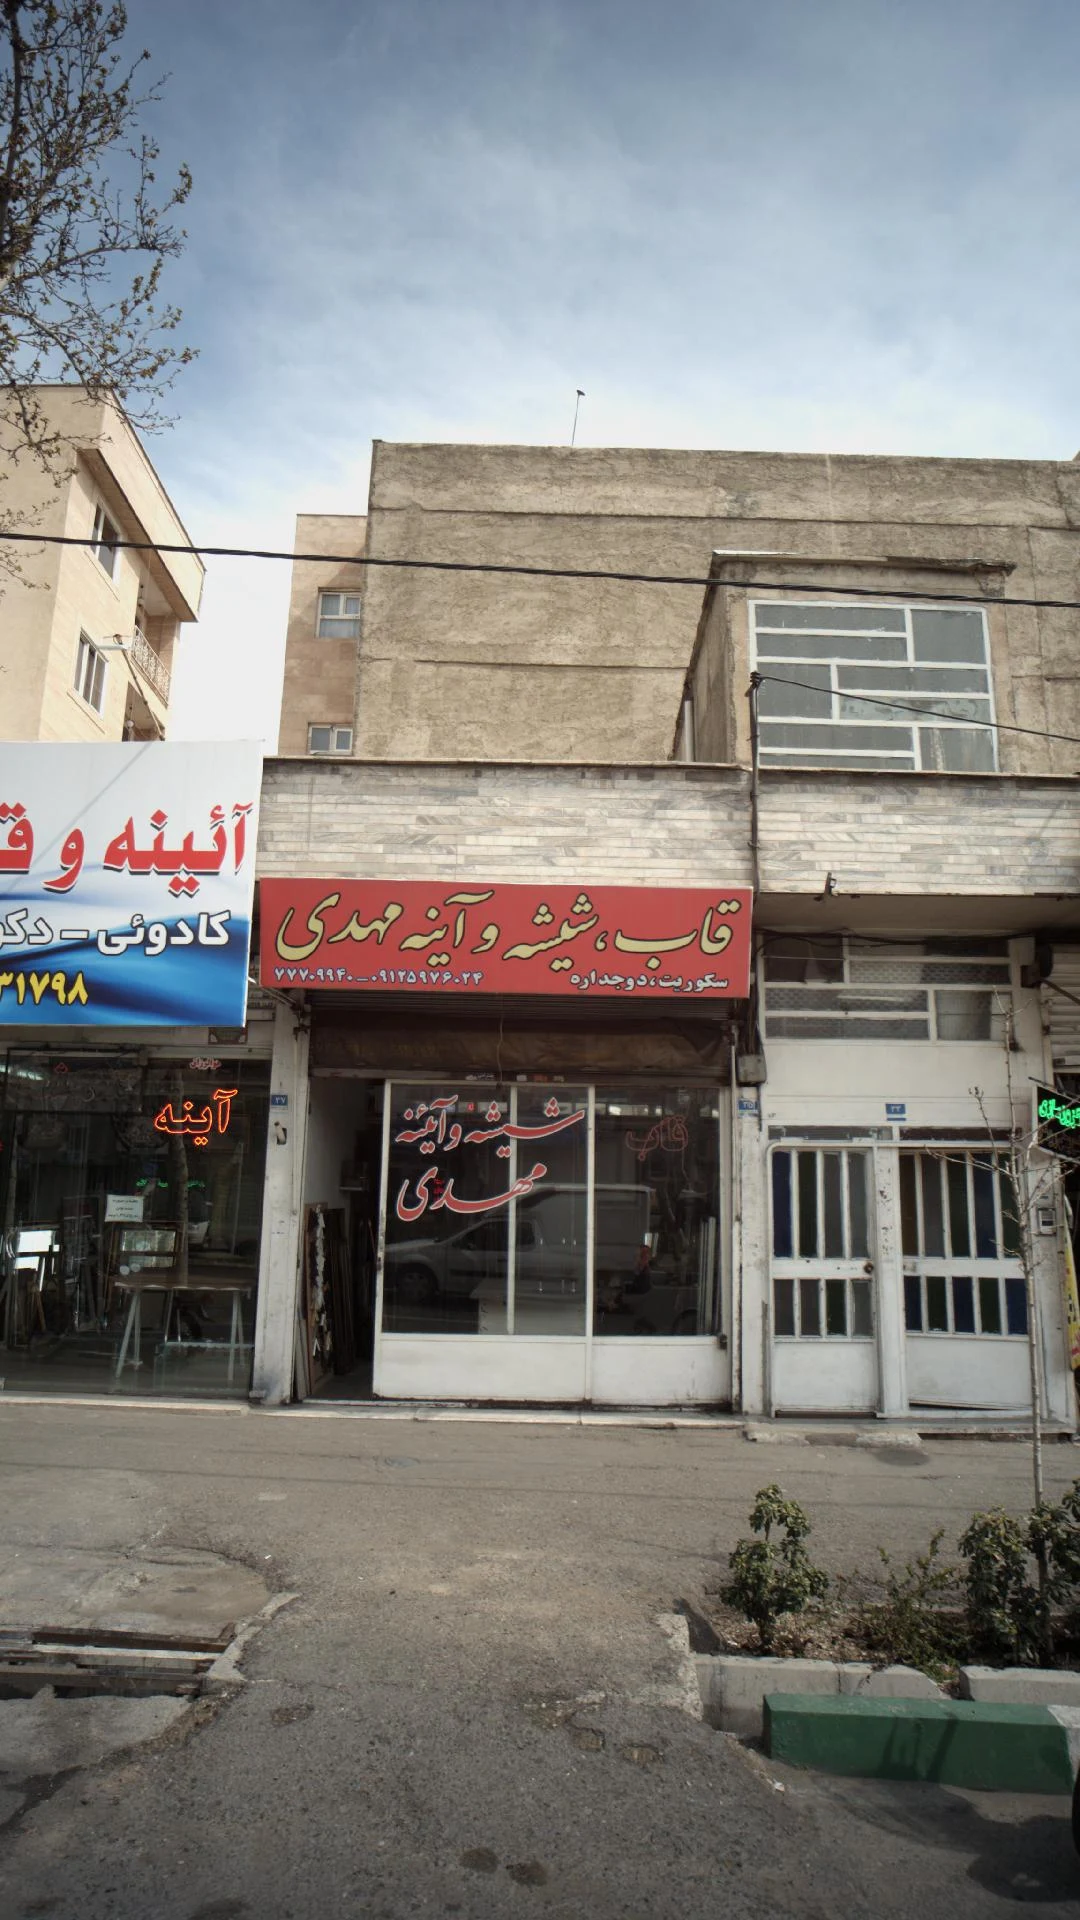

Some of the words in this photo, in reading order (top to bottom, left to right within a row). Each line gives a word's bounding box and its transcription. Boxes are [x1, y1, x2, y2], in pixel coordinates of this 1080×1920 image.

[42, 827, 85, 894] و
[103, 801, 254, 898] آئینه
[276, 891, 404, 962] مهدی
[399, 889, 495, 967] آینه
[471, 923, 500, 954] و
[502, 892, 599, 972] شیشه
[153, 1088, 239, 1147] آینه
[443, 1122, 462, 1152] و
[463, 1096, 587, 1158] شیشه
[625, 1113, 689, 1162] قاب
[397, 1162, 548, 1222] مهدی
